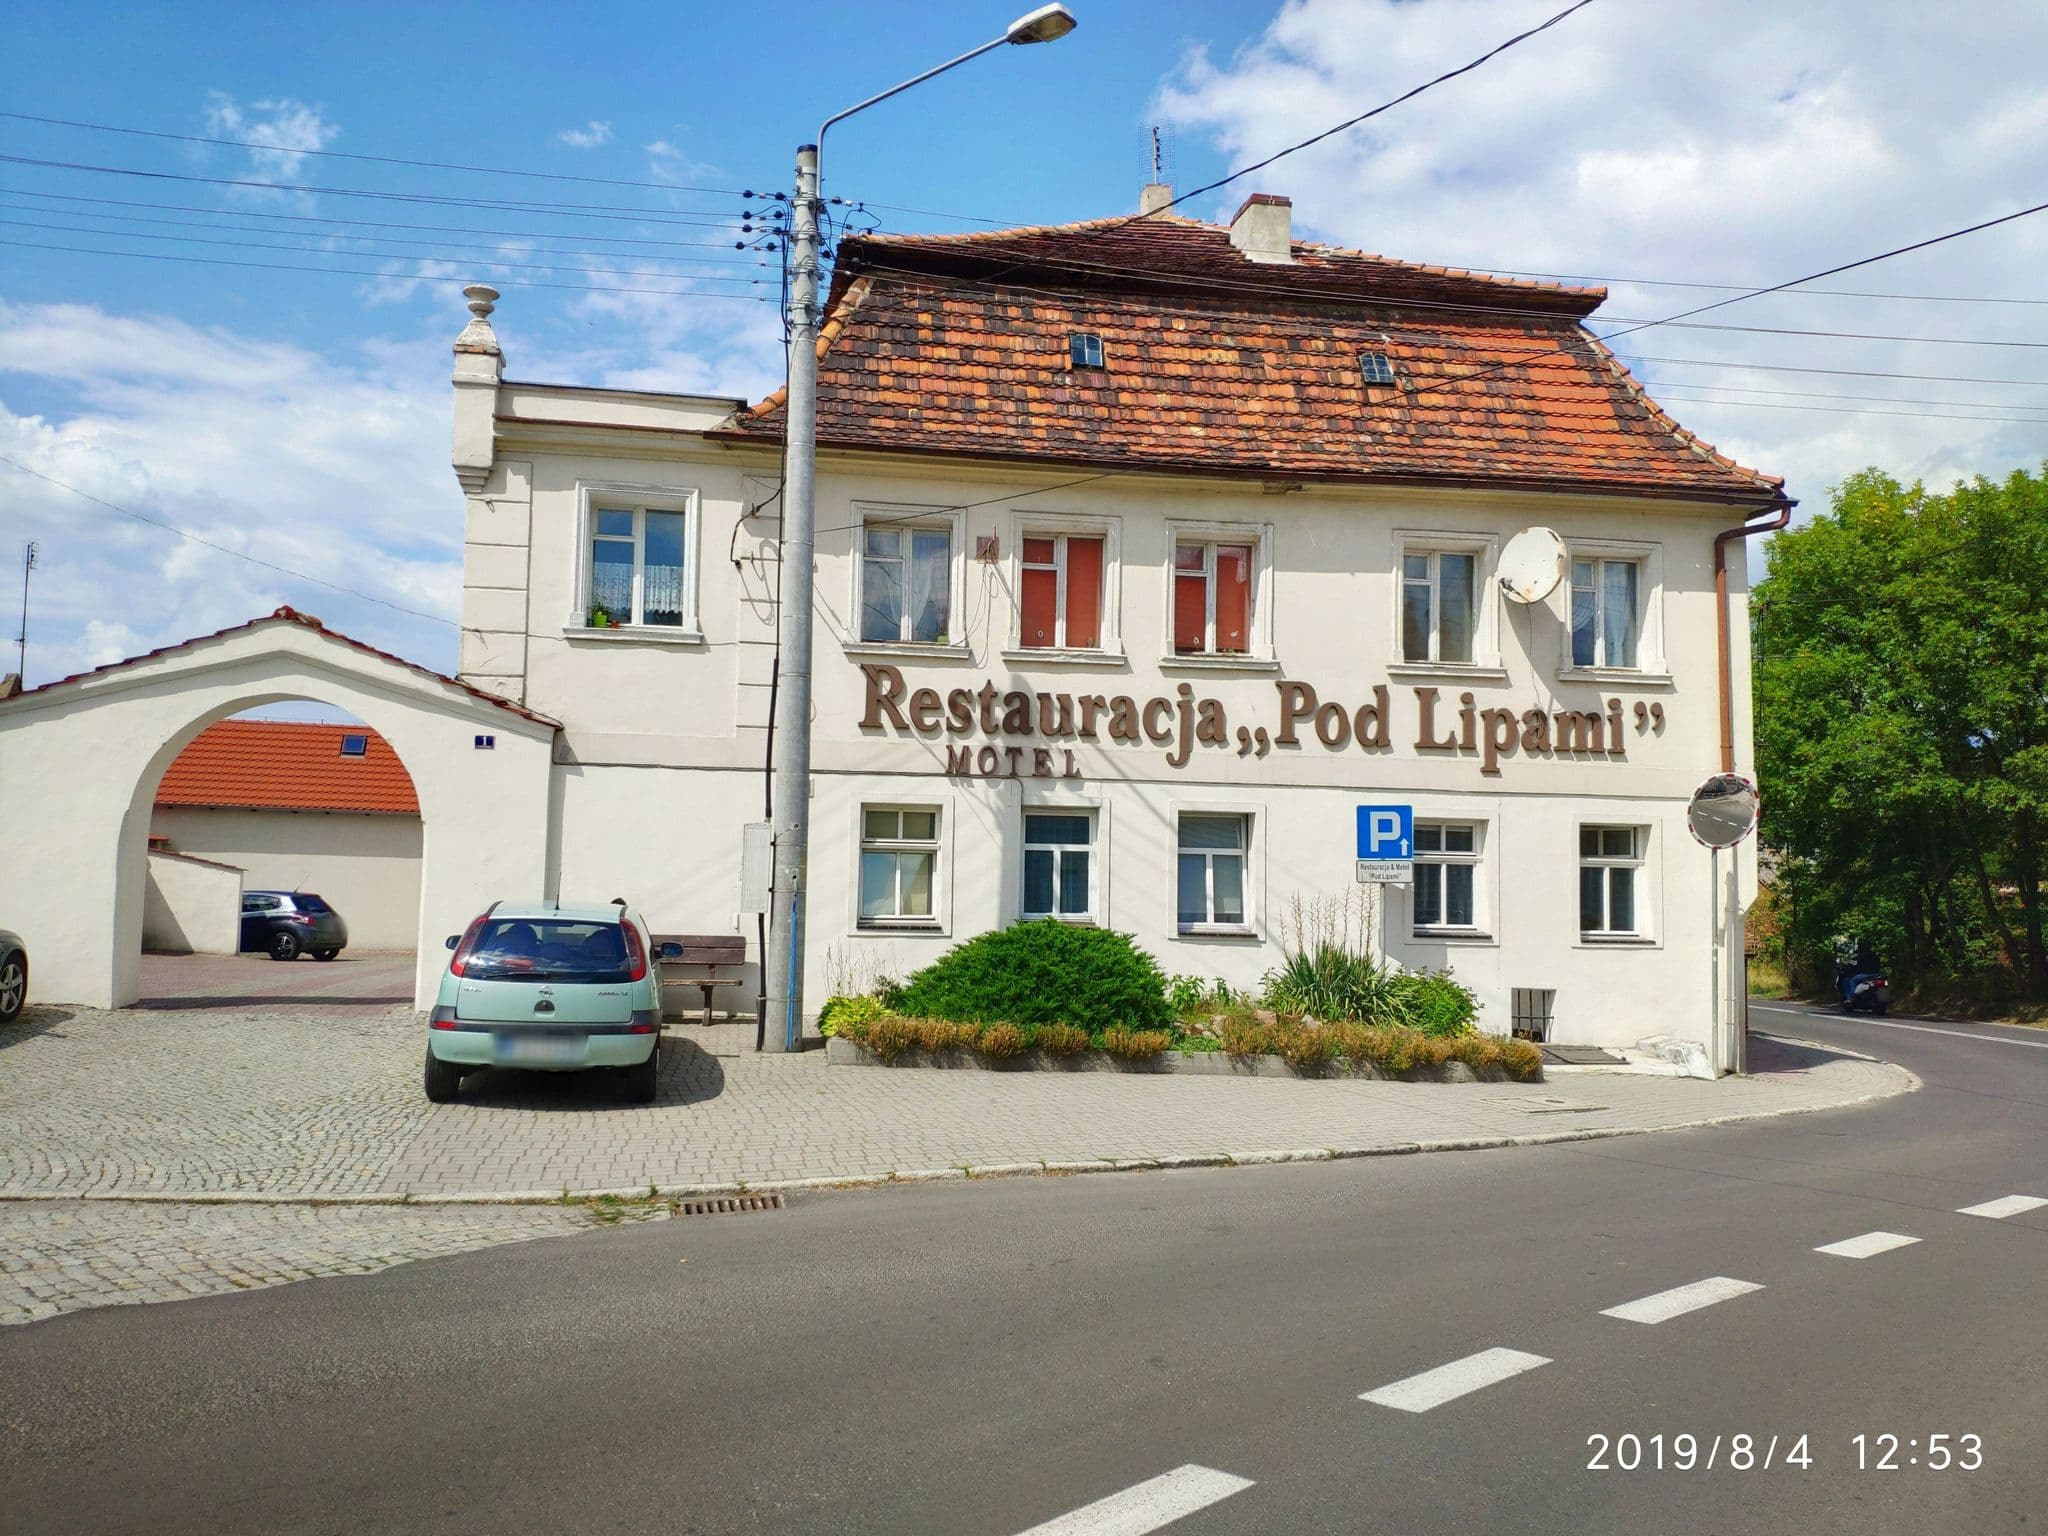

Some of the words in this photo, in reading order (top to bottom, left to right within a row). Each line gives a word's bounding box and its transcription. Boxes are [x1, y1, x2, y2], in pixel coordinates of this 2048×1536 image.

[858, 663, 1227, 767] Restauracja
[945, 744, 1082, 777] MOTEL
[1369, 810, 1402, 853] P
